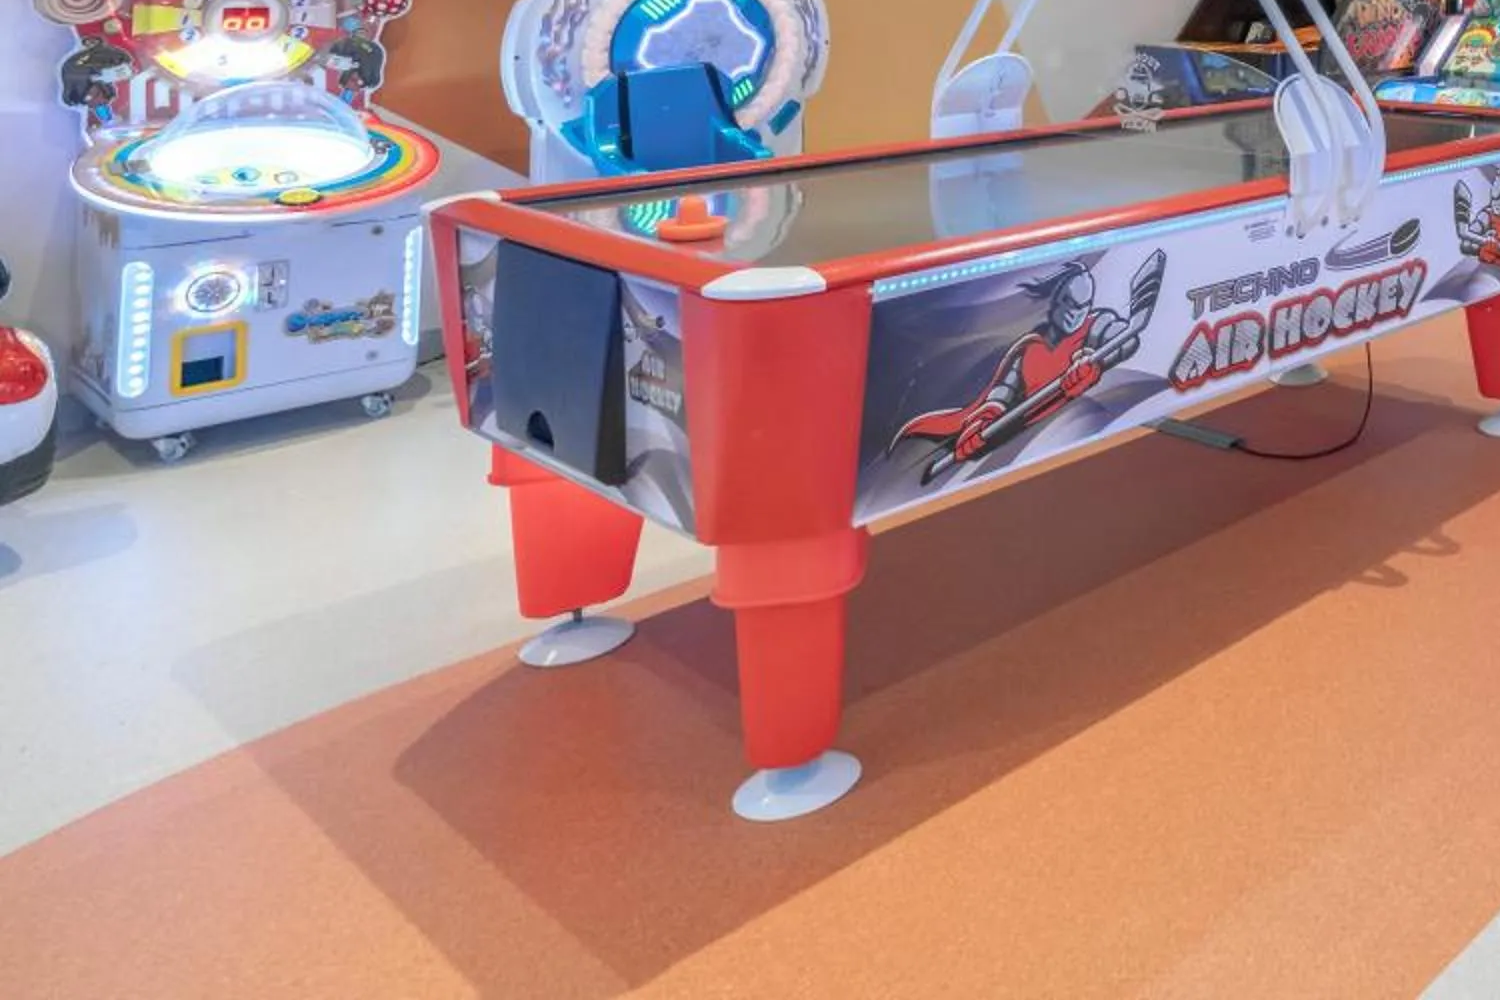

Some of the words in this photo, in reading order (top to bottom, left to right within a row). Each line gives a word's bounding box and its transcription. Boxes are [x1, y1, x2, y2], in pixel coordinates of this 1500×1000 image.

[1169, 312, 1265, 391] AIR
[1268, 259, 1427, 357] HOCKEY
[1186, 257, 1321, 320] TECHNO
